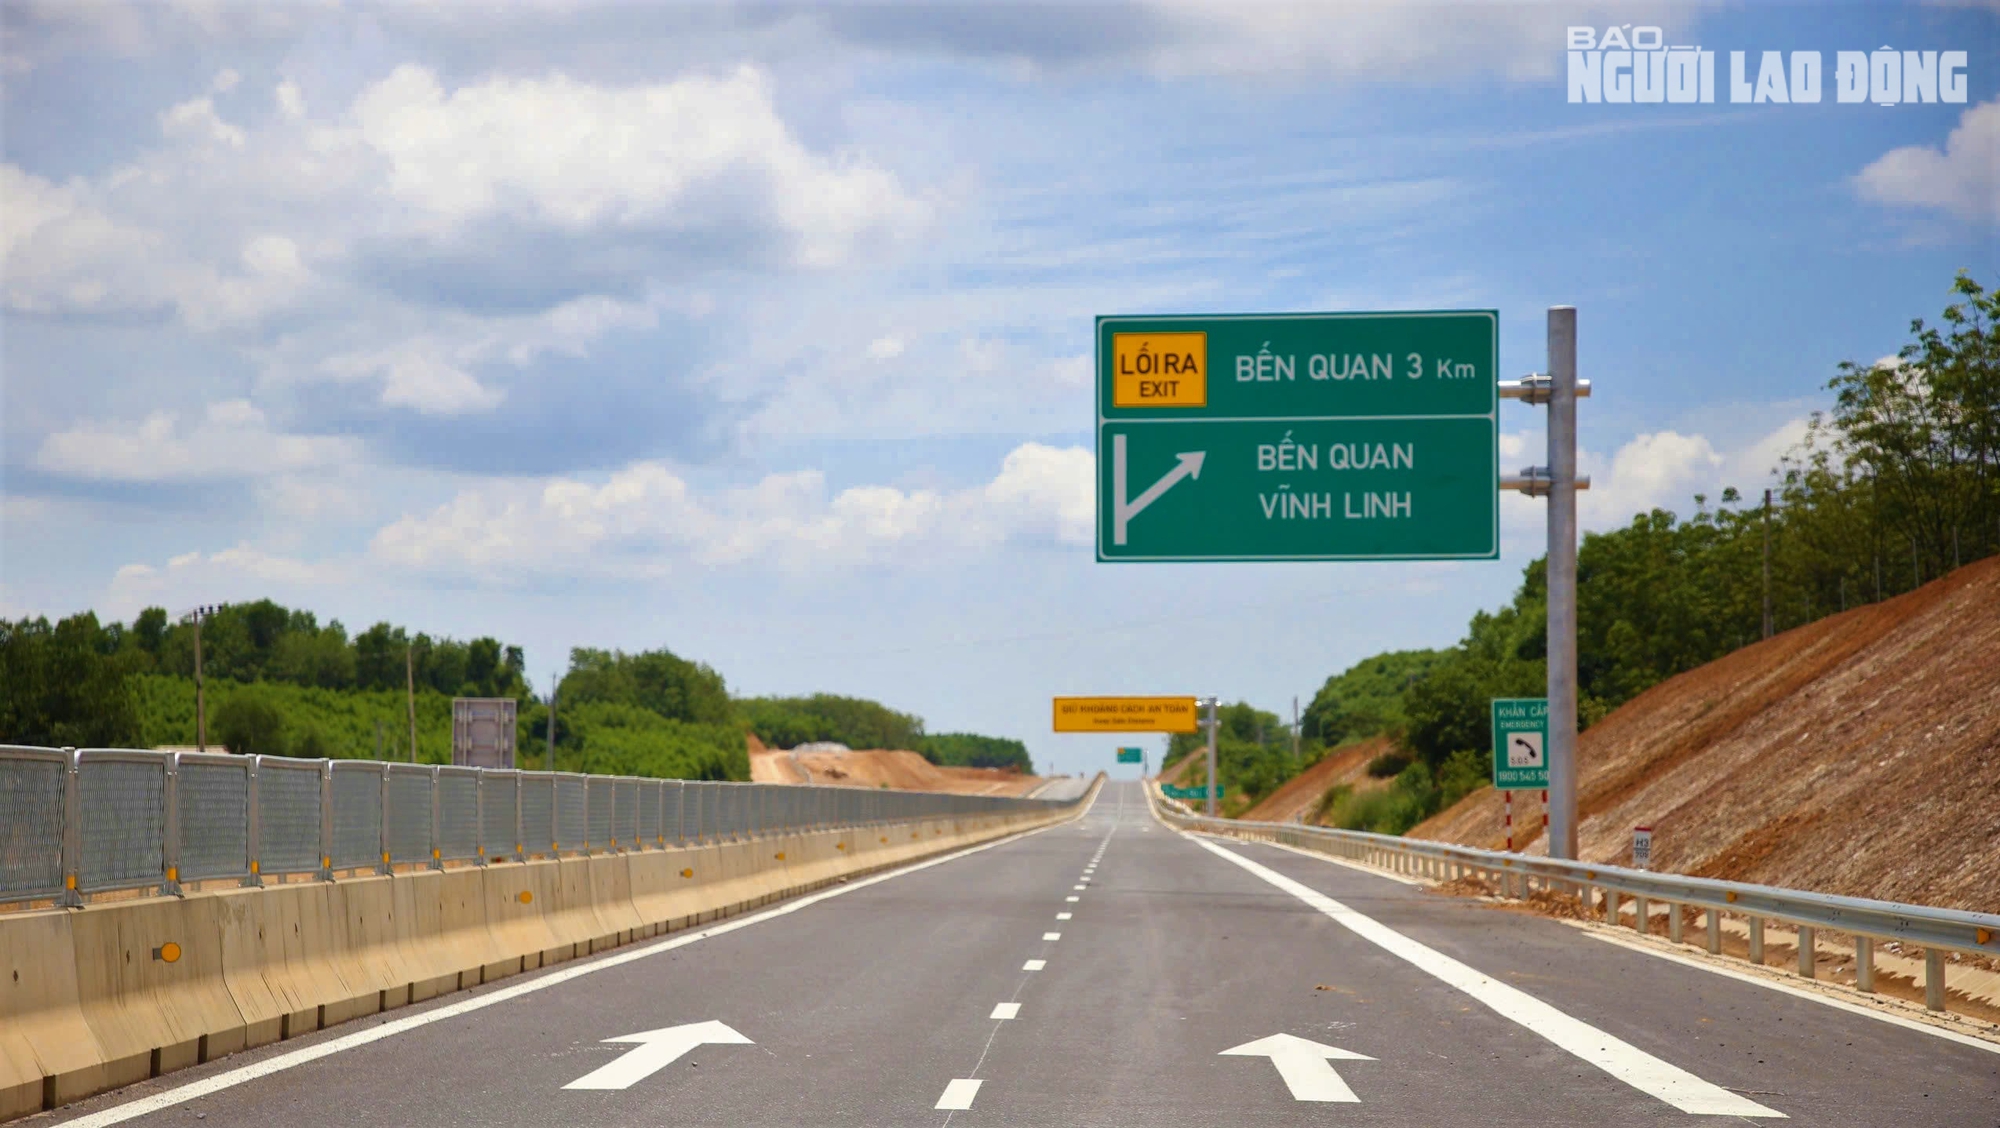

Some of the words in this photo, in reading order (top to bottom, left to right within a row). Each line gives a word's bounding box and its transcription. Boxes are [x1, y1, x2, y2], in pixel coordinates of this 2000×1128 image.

[1164, 352, 1199, 374] RA
[1236, 341, 1296, 382] BẾN
[1308, 353, 1393, 380] QUAN
[1407, 352, 1423, 379] 3
[1437, 359, 1476, 379] Km
[1139, 380, 1180, 398] EXIT
[1258, 430, 1318, 470] BẾN
[1329, 443, 1414, 470] QUAN
[1259, 484, 1331, 520] VĨNH
[1345, 493, 1412, 519] LINH
[1501, 720, 1545, 729] EMERGENCY
